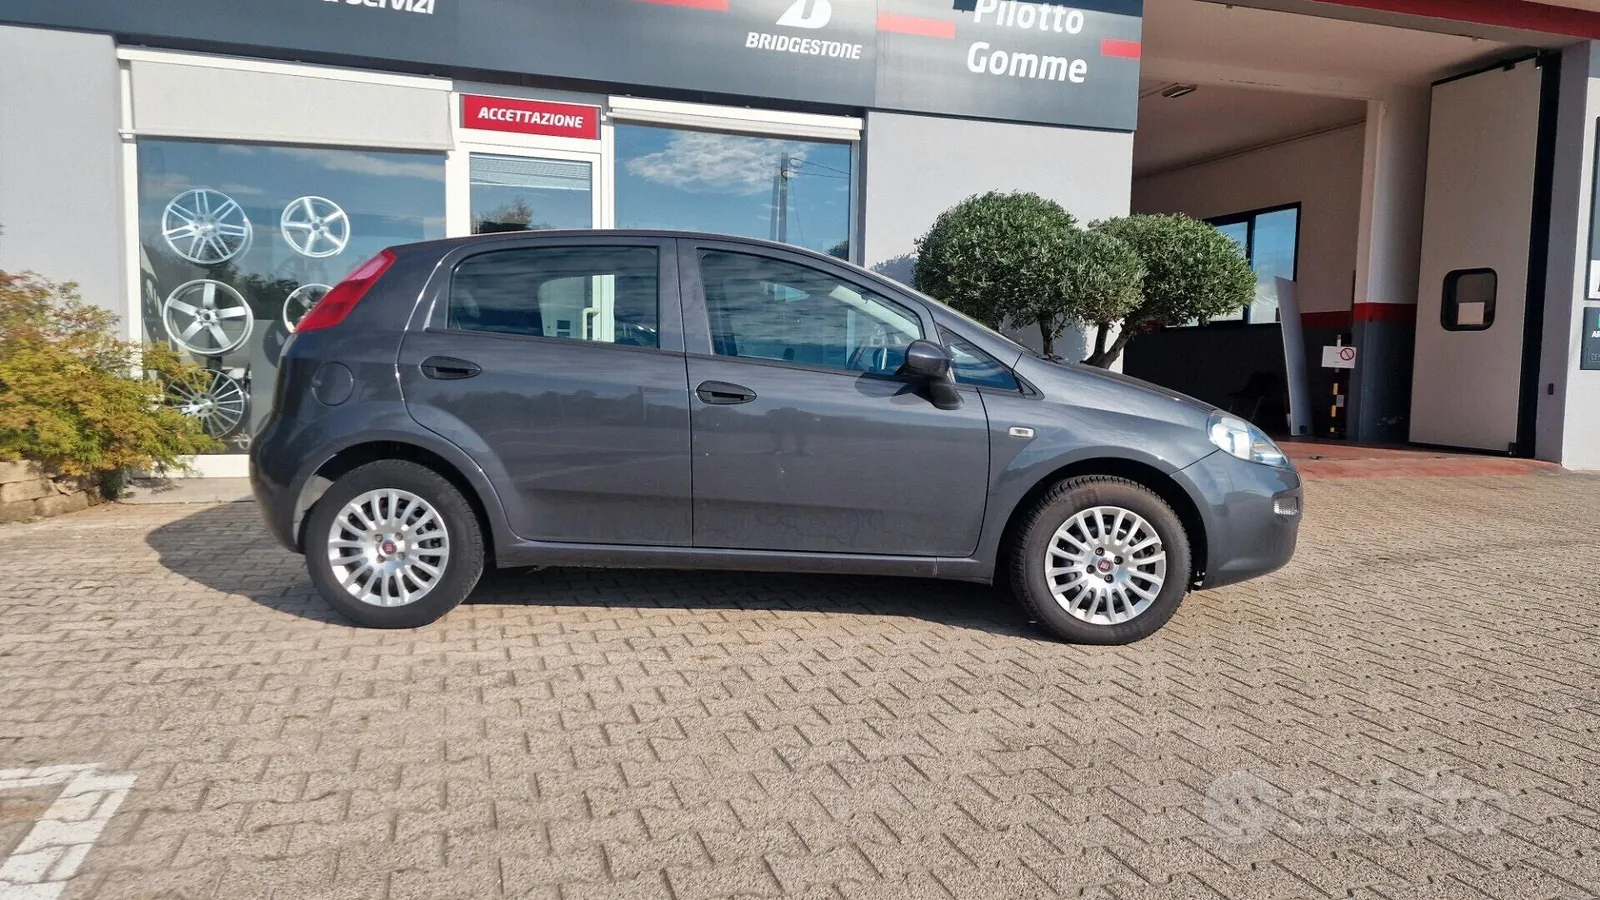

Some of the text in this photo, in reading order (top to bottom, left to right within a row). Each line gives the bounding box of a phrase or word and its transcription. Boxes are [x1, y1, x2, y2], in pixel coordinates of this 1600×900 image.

[973, 0, 1085, 35] Pilotto
[745, 31, 863, 60] BRIDGESTONE
[967, 41, 1088, 84] Gomme
[477, 106, 584, 128] ACCETTAZIONE
